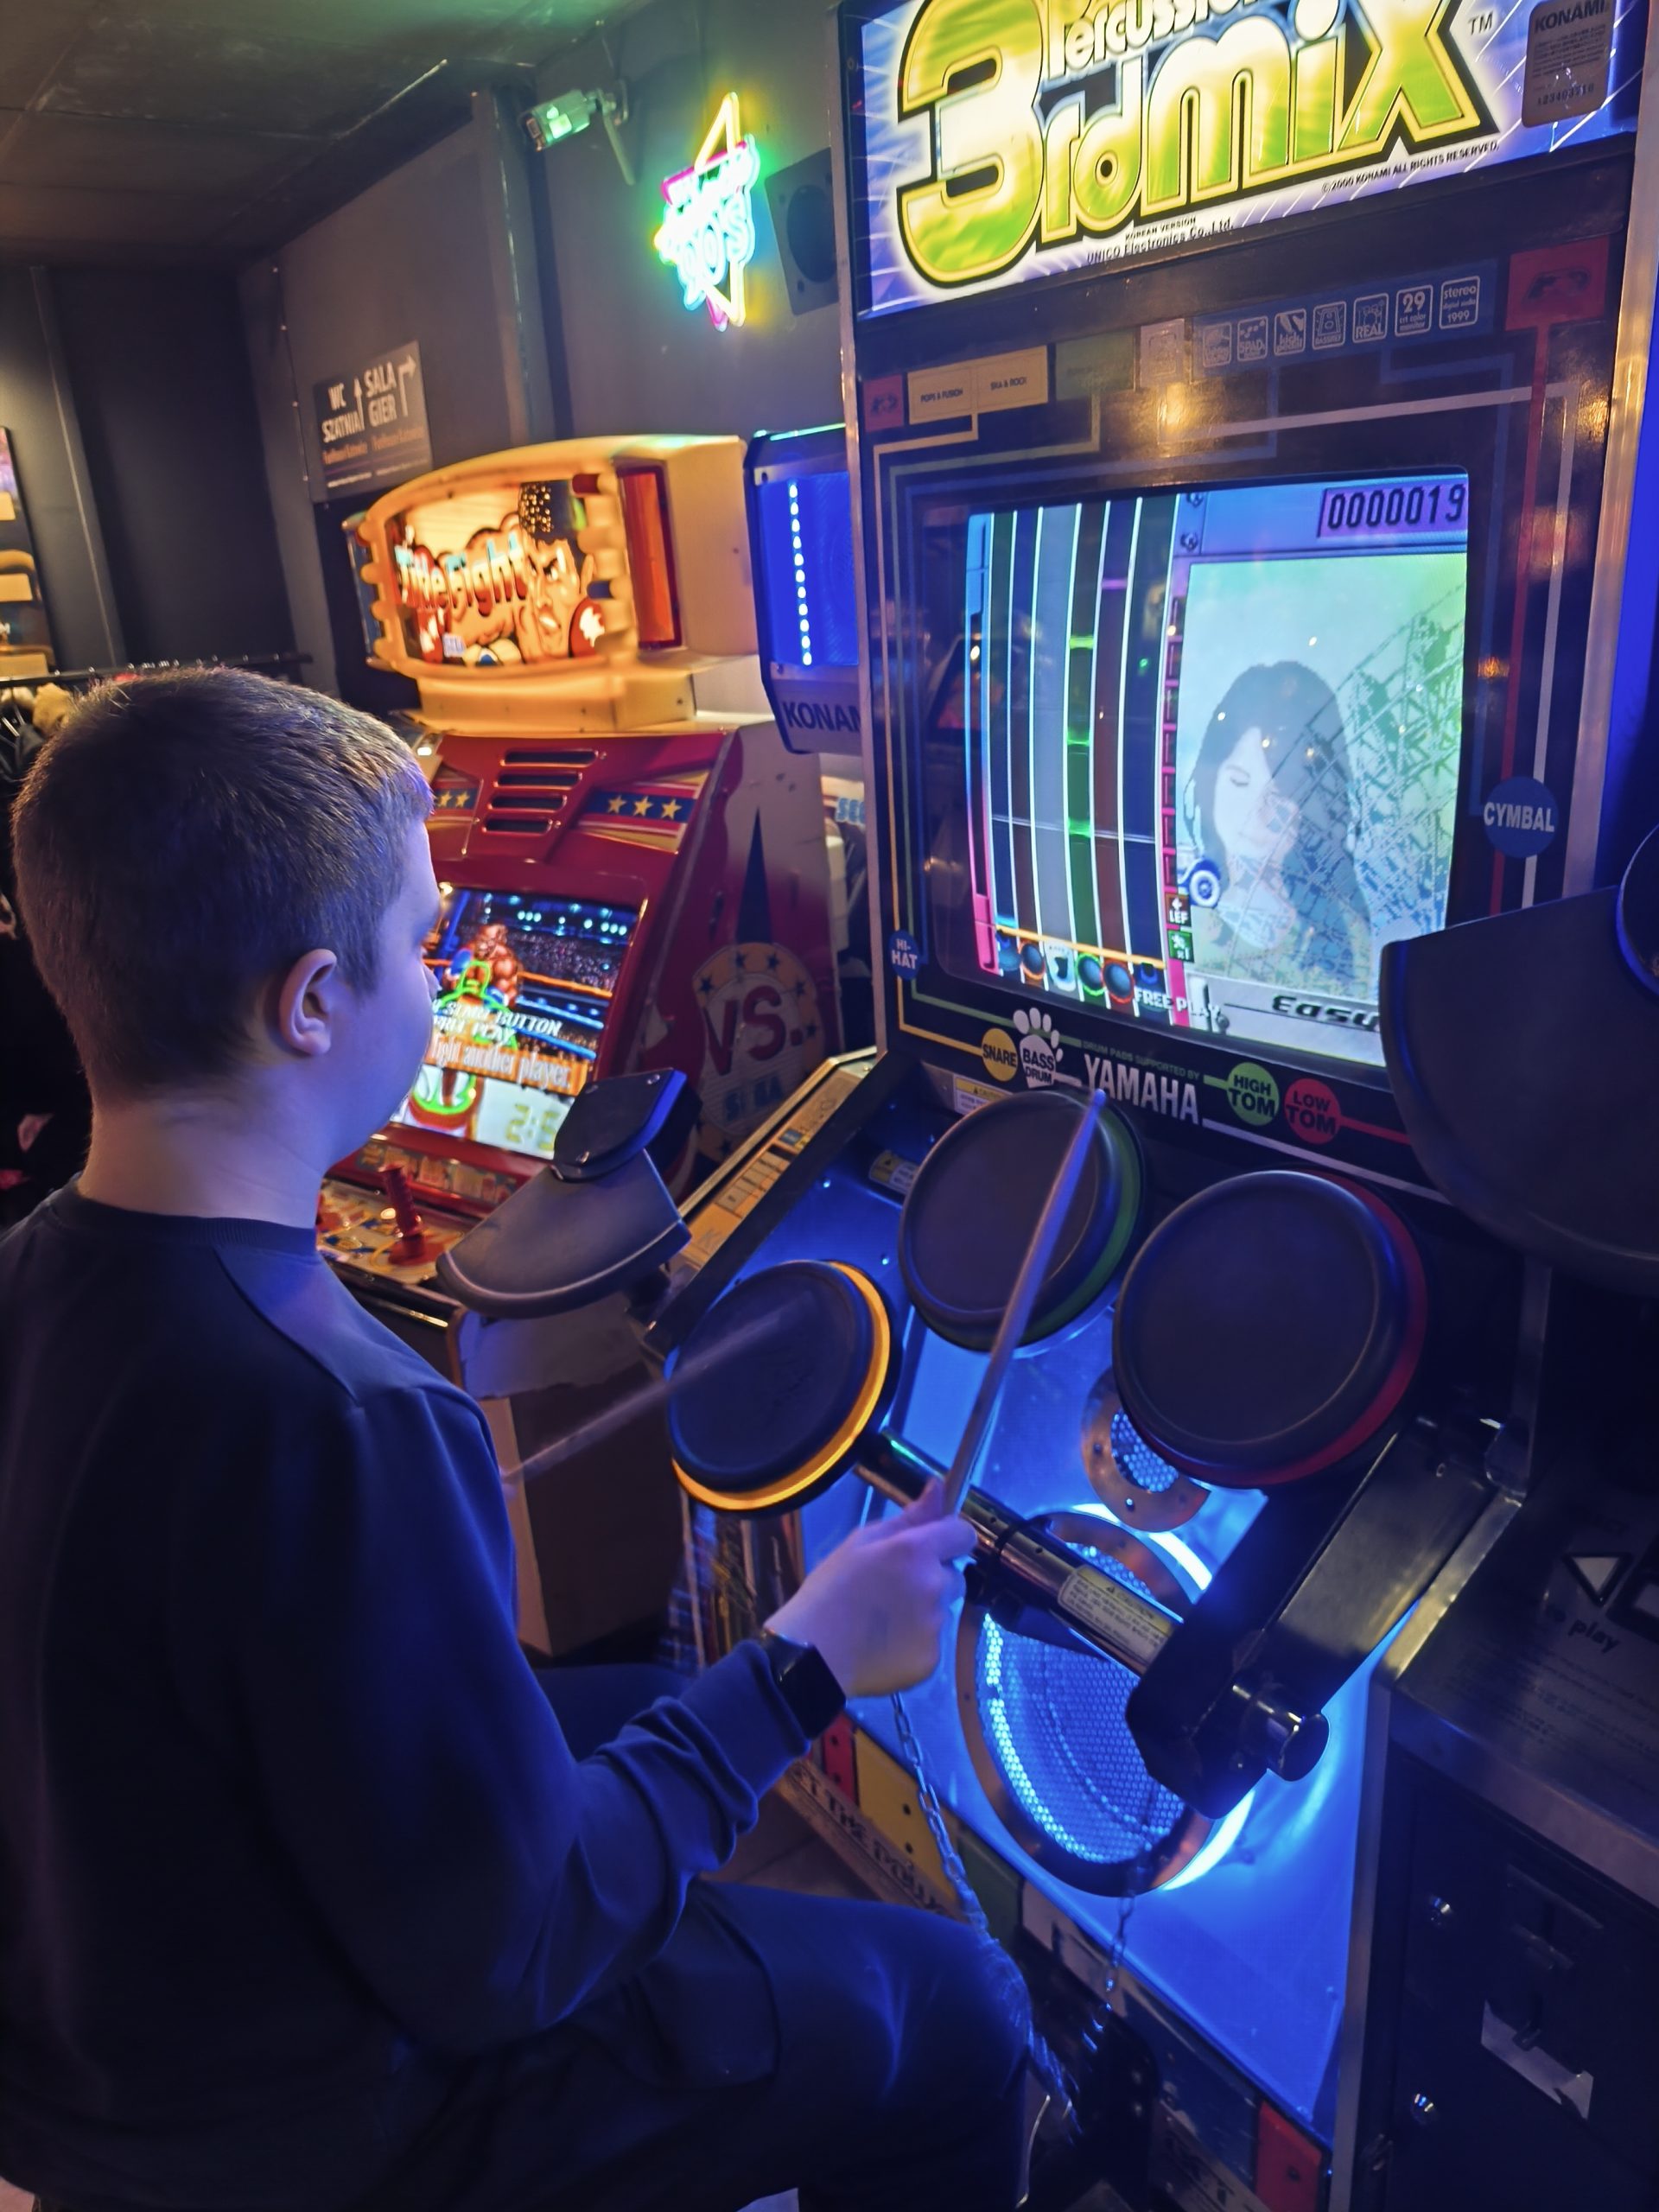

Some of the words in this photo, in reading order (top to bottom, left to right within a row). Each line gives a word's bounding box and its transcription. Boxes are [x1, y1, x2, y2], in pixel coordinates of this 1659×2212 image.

[1469, 11, 1494, 35] TM
[1535, 0, 1605, 33] KONAMI
[1048, 0, 1257, 79] Percuss
[1356, 167, 1390, 186] KONAMI
[1393, 162, 1408, 176] ALL
[1410, 156, 1445, 171] RIGHTS
[1125, 226, 1158, 241] KOREAN
[1160, 216, 1196, 232] VERSION
[1124, 232, 1185, 255] Electronics
[1402, 291, 1426, 314] 29
[1444, 285, 1477, 300] stereo
[1448, 309, 1470, 323] 1999
[364, 361, 397, 398] SALA
[328, 383, 346, 410] WC
[1327, 483, 1466, 530] 0000019
[1484, 802, 1554, 832] CYMBAL
[892, 950, 918, 969] HAT
[1134, 988, 1173, 1010] FREE
[496, 1011, 563, 1036] BUTTON
[982, 1044, 1017, 1068] SNARE
[1023, 1048, 1054, 1071] BASS
[1025, 1066, 1052, 1084] DRUM
[1234, 1075, 1271, 1096] HIGH
[1084, 1053, 1199, 1124] YAMAHA
[1294, 1090, 1331, 1111] LOW
[1229, 1088, 1275, 1117] TOM
[1286, 1103, 1335, 1134] TOM
